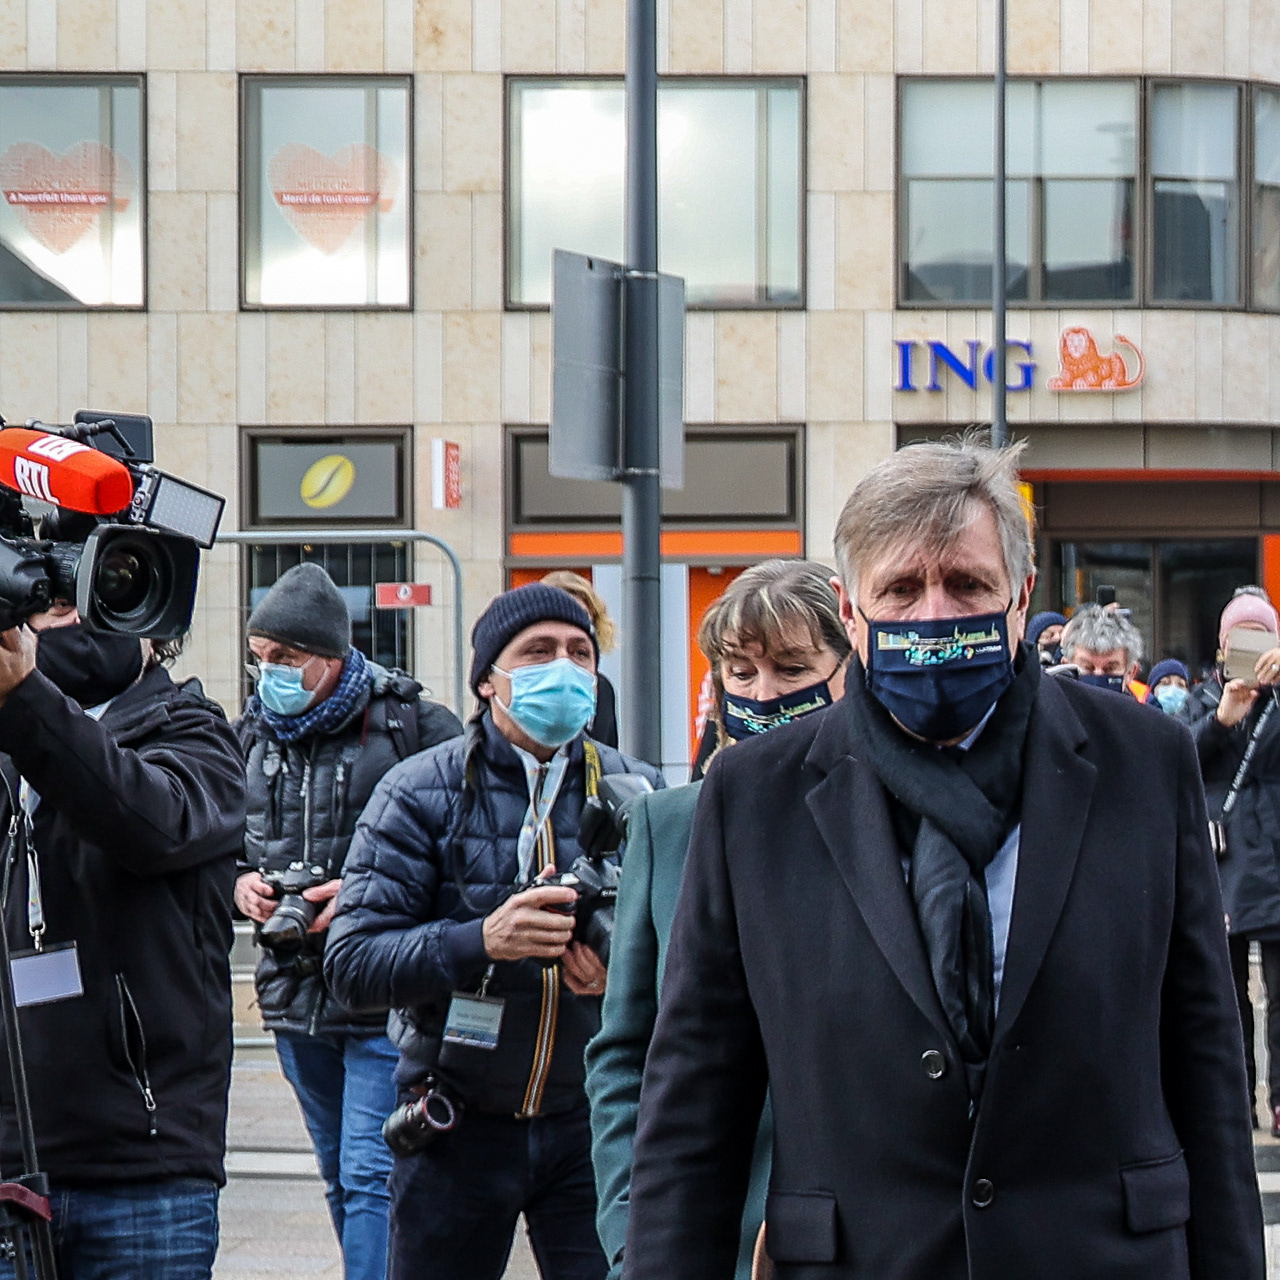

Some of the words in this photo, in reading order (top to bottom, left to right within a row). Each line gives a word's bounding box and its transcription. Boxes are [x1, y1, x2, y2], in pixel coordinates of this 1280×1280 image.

[9, 193, 16, 202] A
[18, 193, 58, 203] heartfelt
[60, 193, 88, 203] thank
[89, 195, 107, 205] you
[282, 194, 307, 203] Merci
[309, 194, 322, 203] de
[323, 194, 342, 203] tout
[893, 339, 1037, 392] ING
[14, 455, 61, 505] RTL
